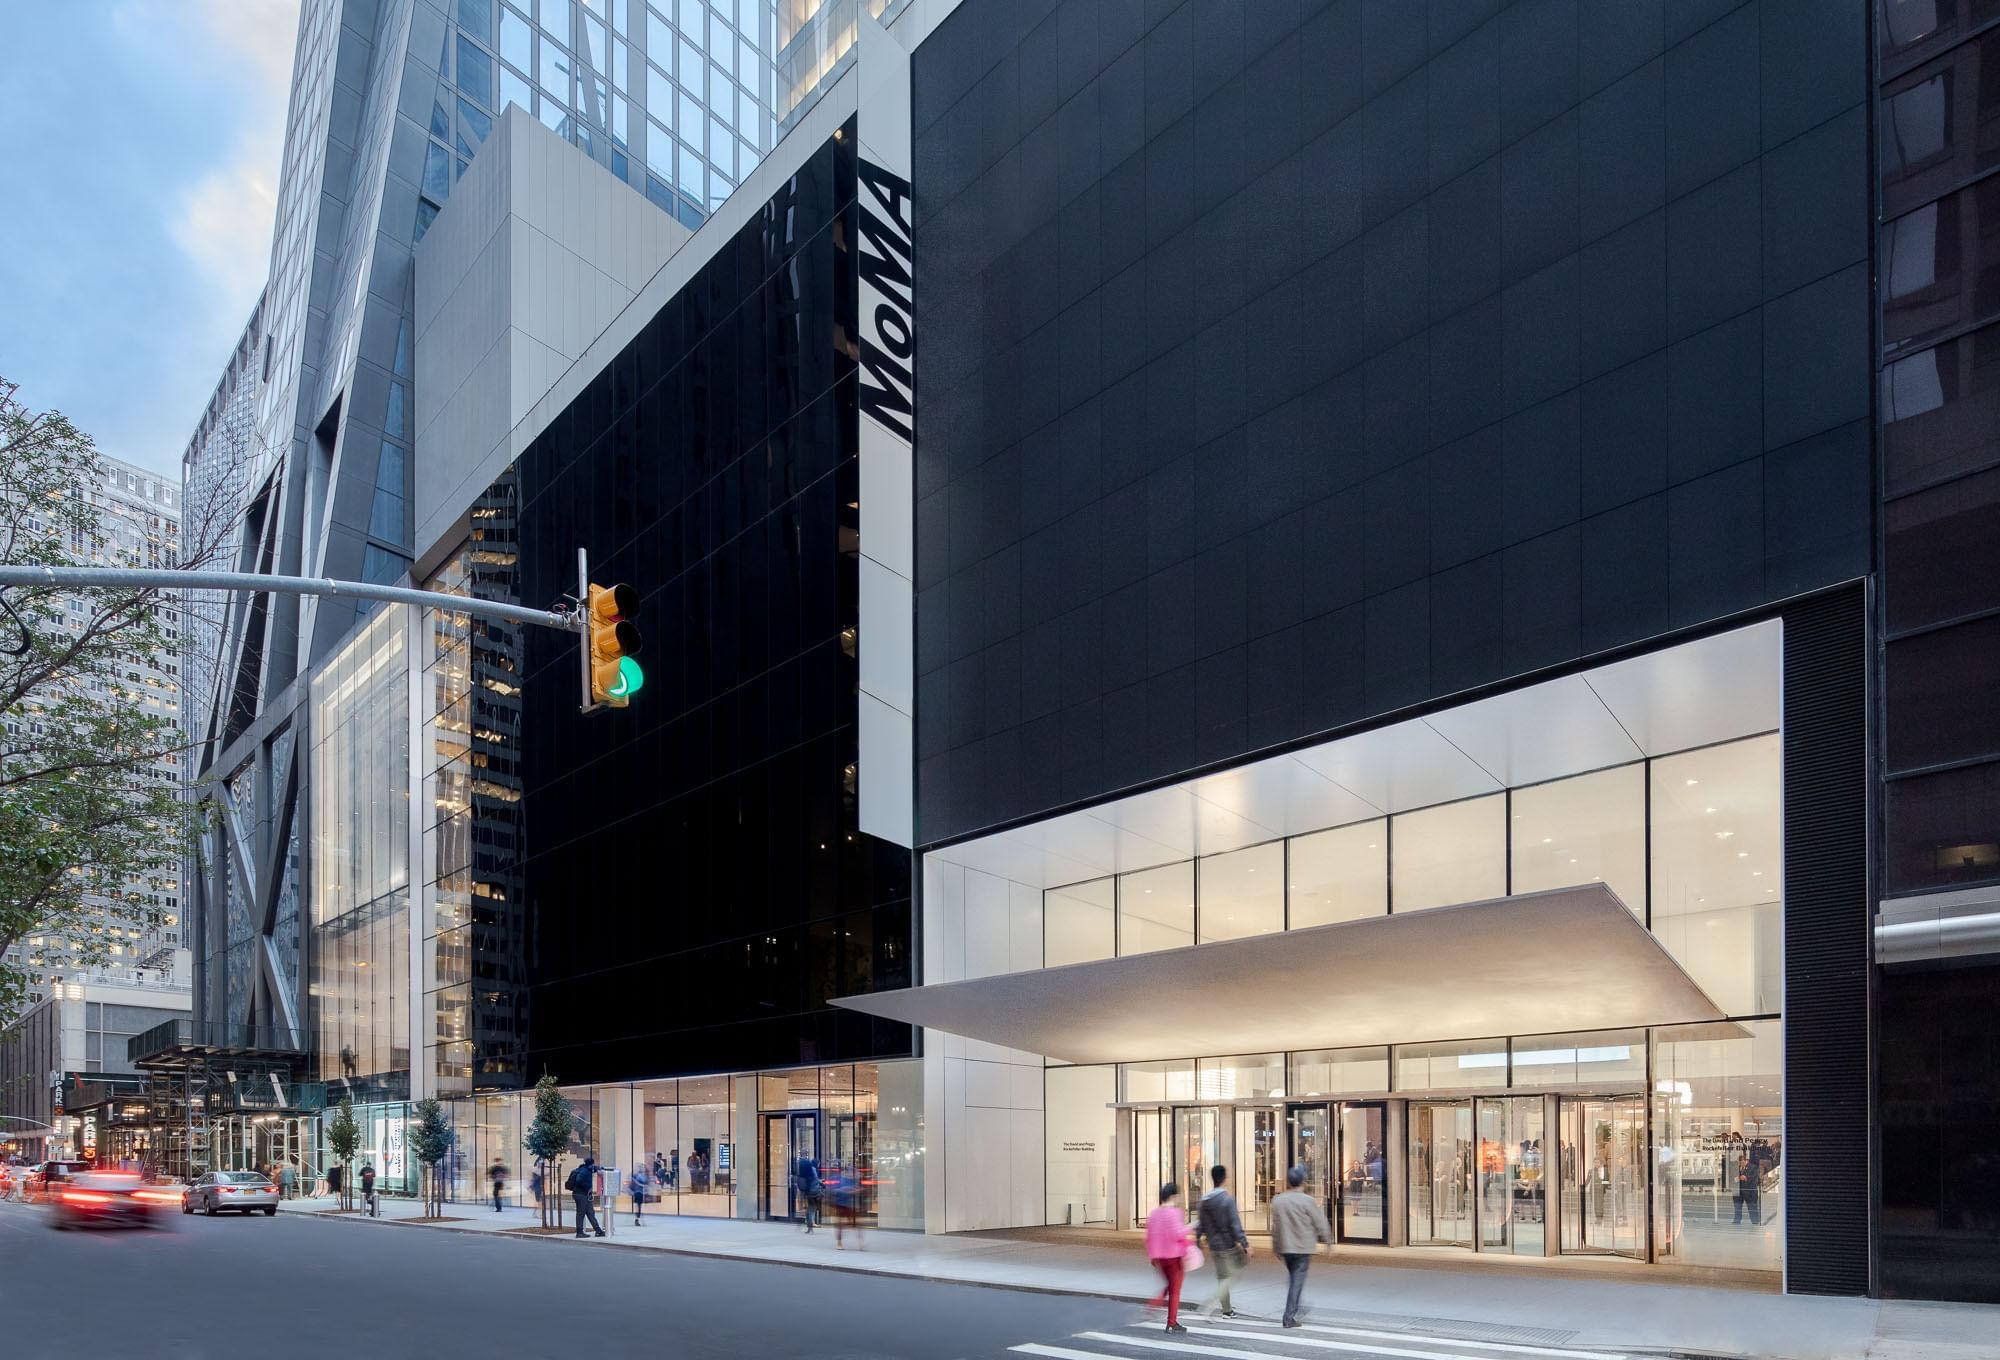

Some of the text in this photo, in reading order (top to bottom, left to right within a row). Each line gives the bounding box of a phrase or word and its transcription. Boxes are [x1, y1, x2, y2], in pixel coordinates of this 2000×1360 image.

[858, 157, 913, 444] MoMA
[55, 1080, 63, 1104] PARK
[83, 1116, 97, 1147] PARK
